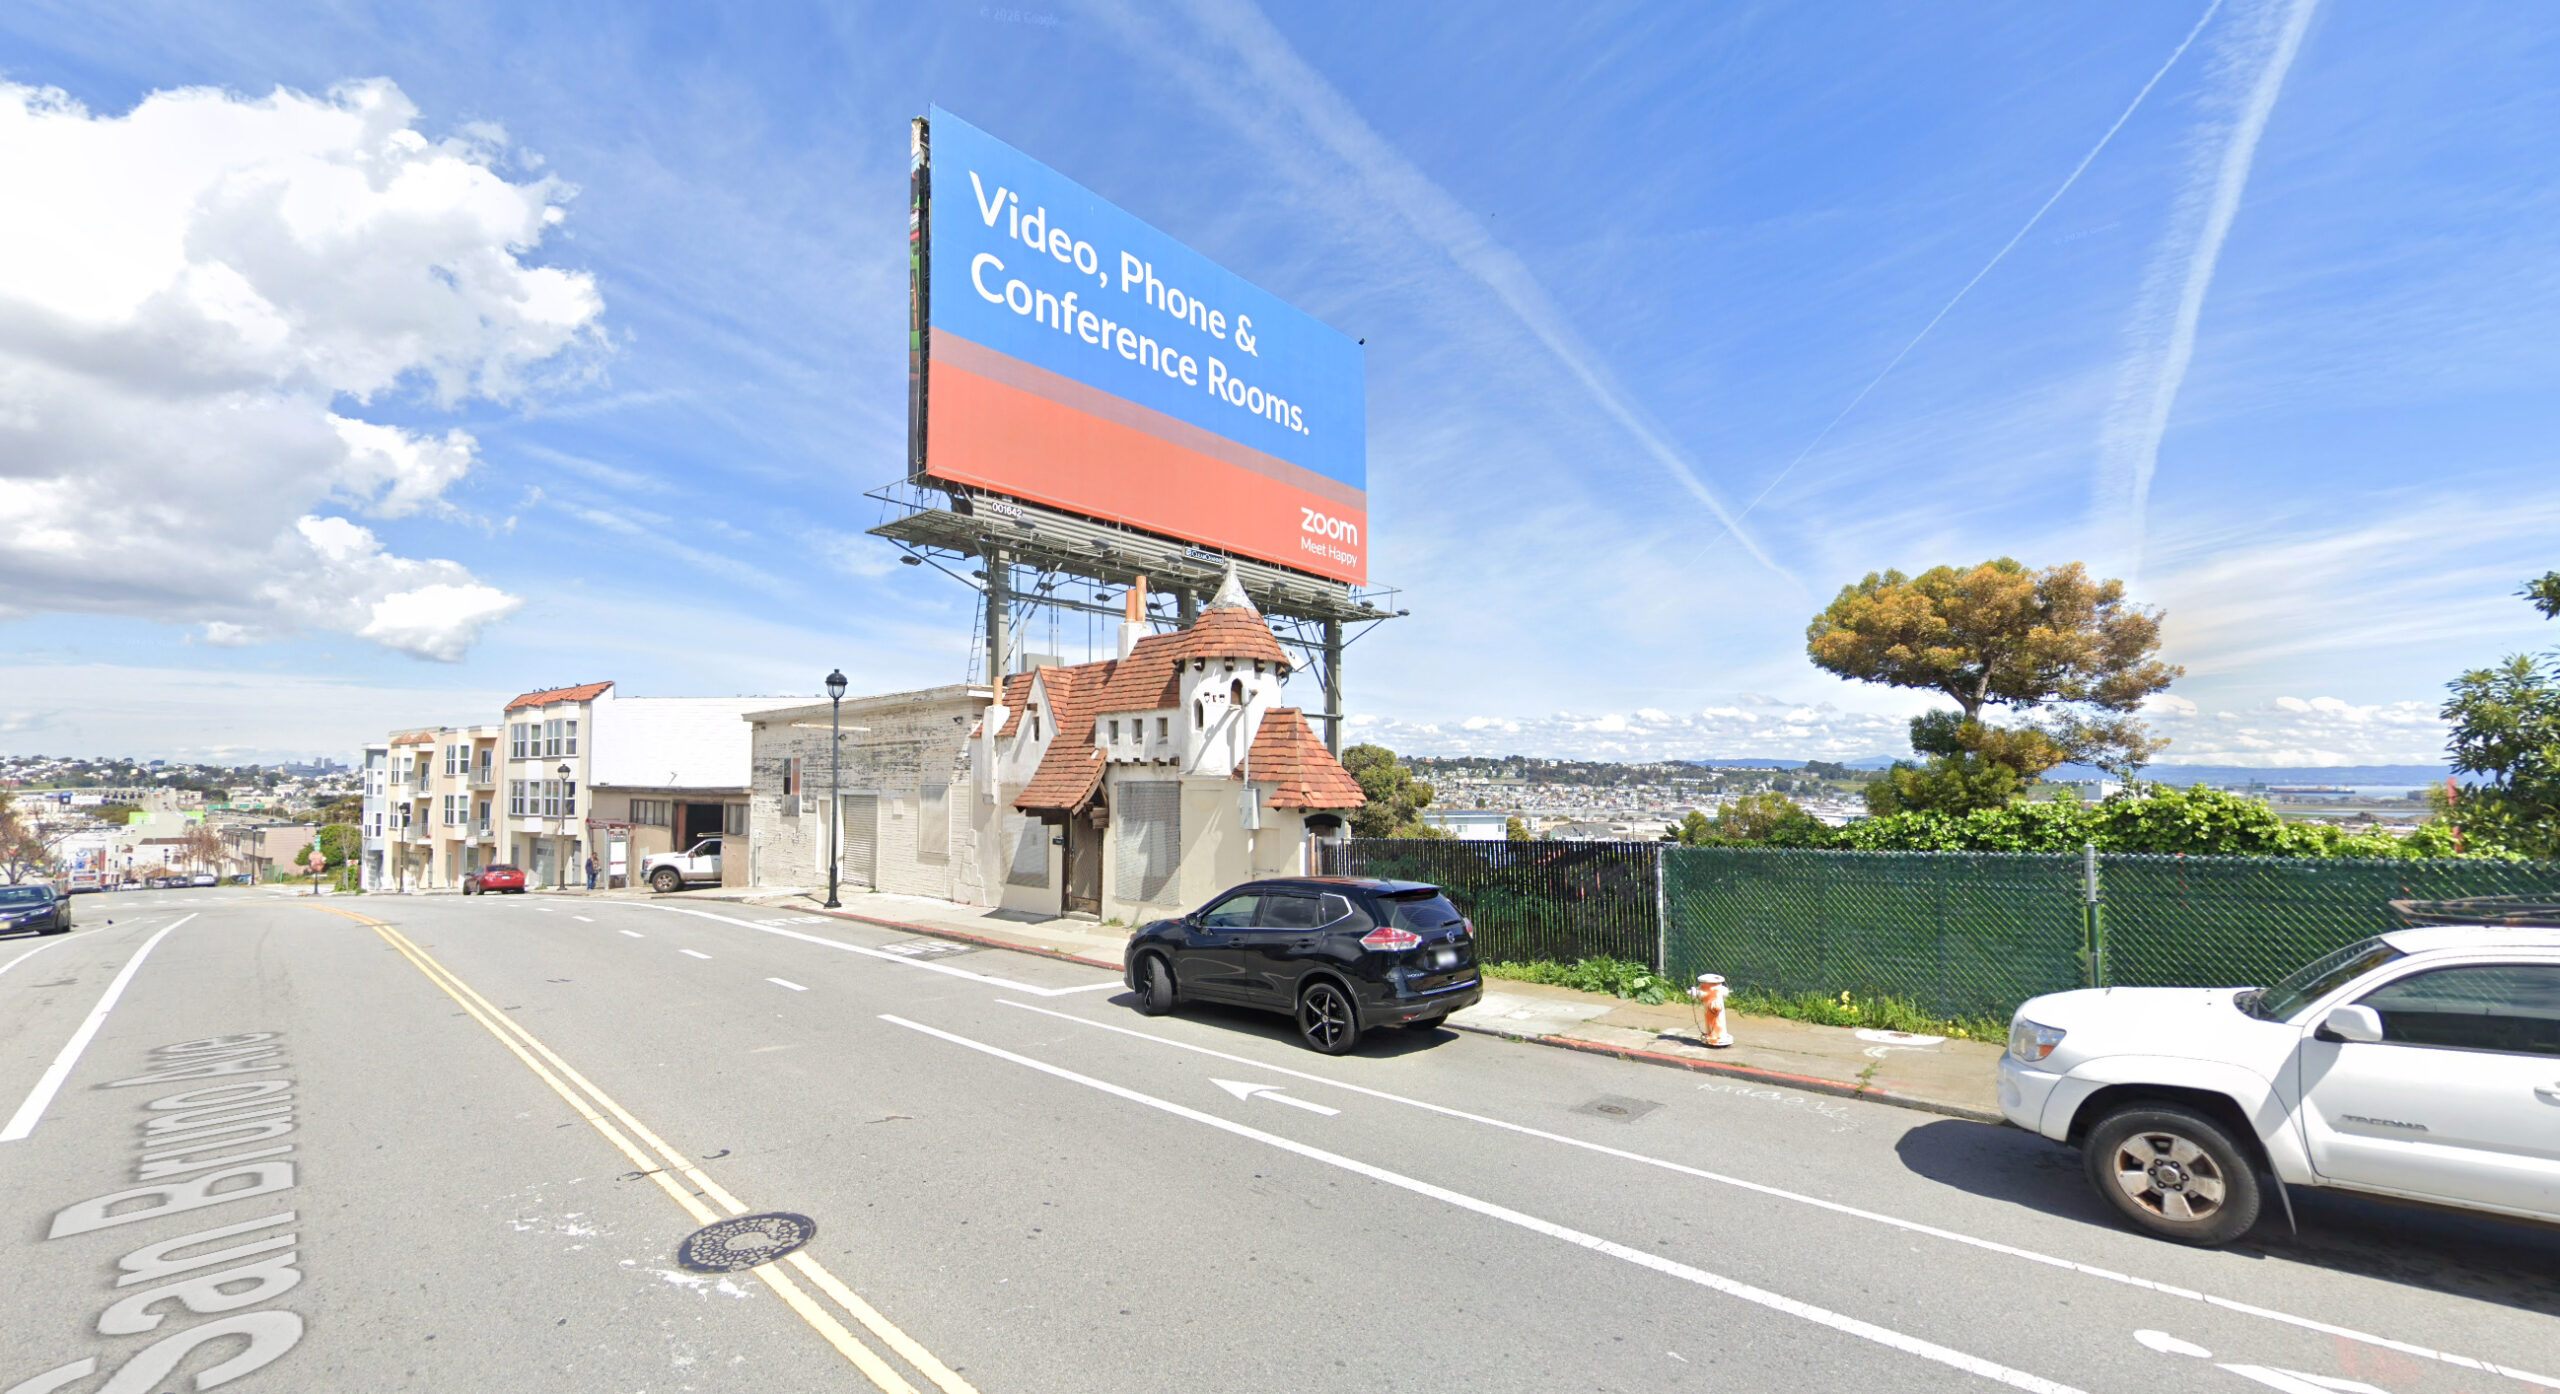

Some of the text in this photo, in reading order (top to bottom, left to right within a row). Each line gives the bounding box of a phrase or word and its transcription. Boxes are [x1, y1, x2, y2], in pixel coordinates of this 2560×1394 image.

[969, 170, 1258, 357] Video, Phone &
[971, 252, 1310, 436] Conference Rooms.
[1300, 506, 1358, 547] zoom
[1301, 536, 1358, 569] Meet Happy
